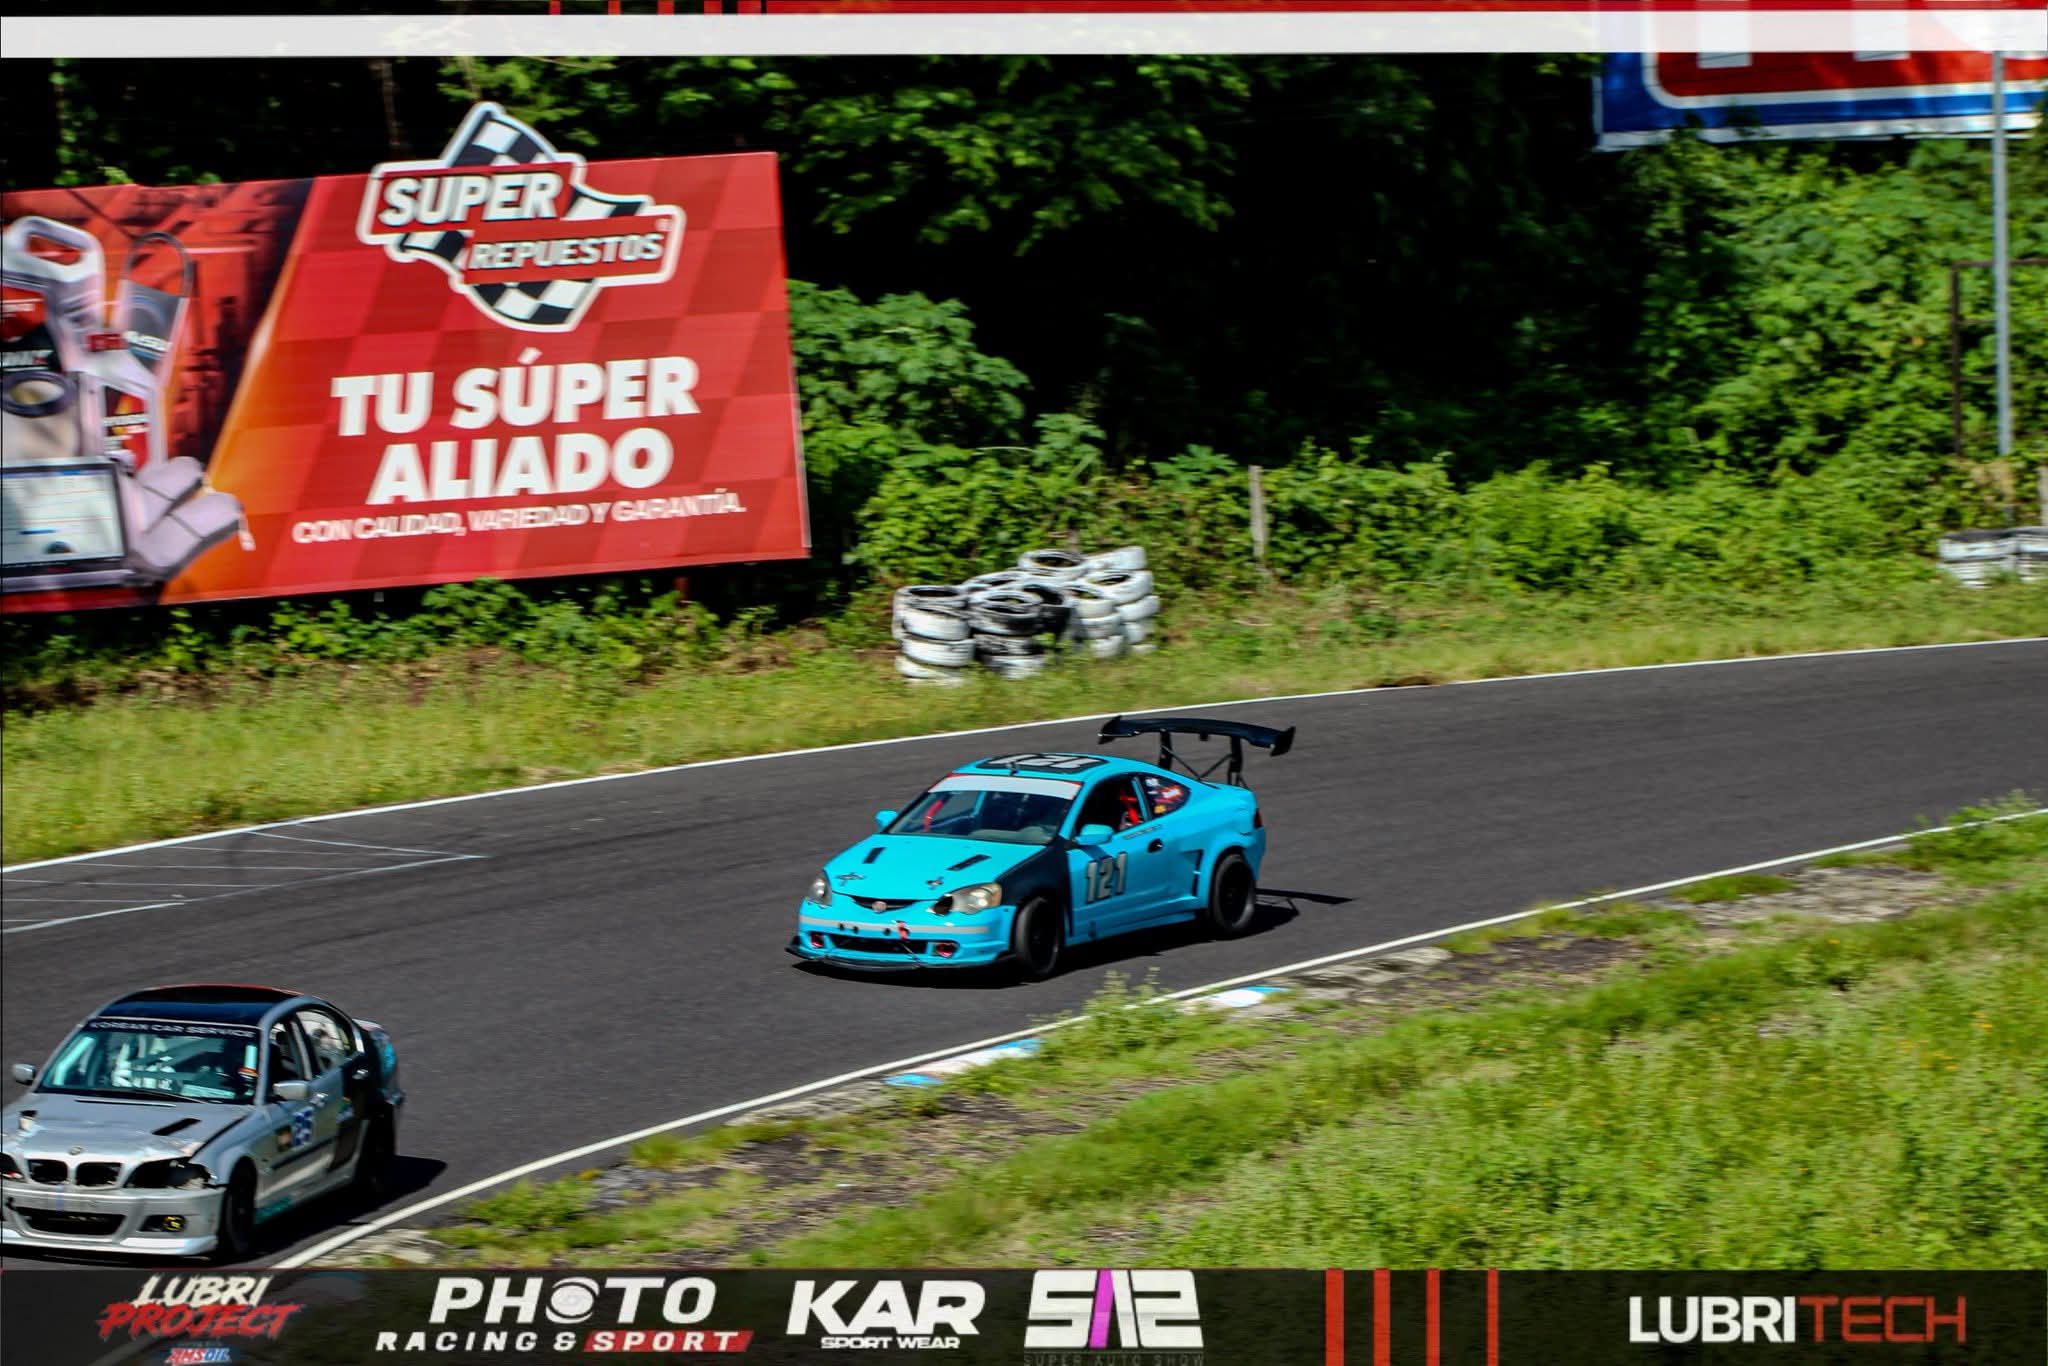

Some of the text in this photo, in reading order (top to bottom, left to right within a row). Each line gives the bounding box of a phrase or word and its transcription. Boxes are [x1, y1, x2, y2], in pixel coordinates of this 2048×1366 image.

[378, 171, 563, 227] SUPER
[468, 231, 664, 271] REPUESTOS
[332, 347, 701, 437] TU SÚPER
[366, 428, 674, 504] ALIADO
[291, 487, 747, 544] CON CALIDAD, VARIEDAD Y GARANTÍA.
[1086, 852, 1128, 903] 121
[151, 1023, 185, 1033] CAR
[186, 1026, 257, 1039] SERVICE
